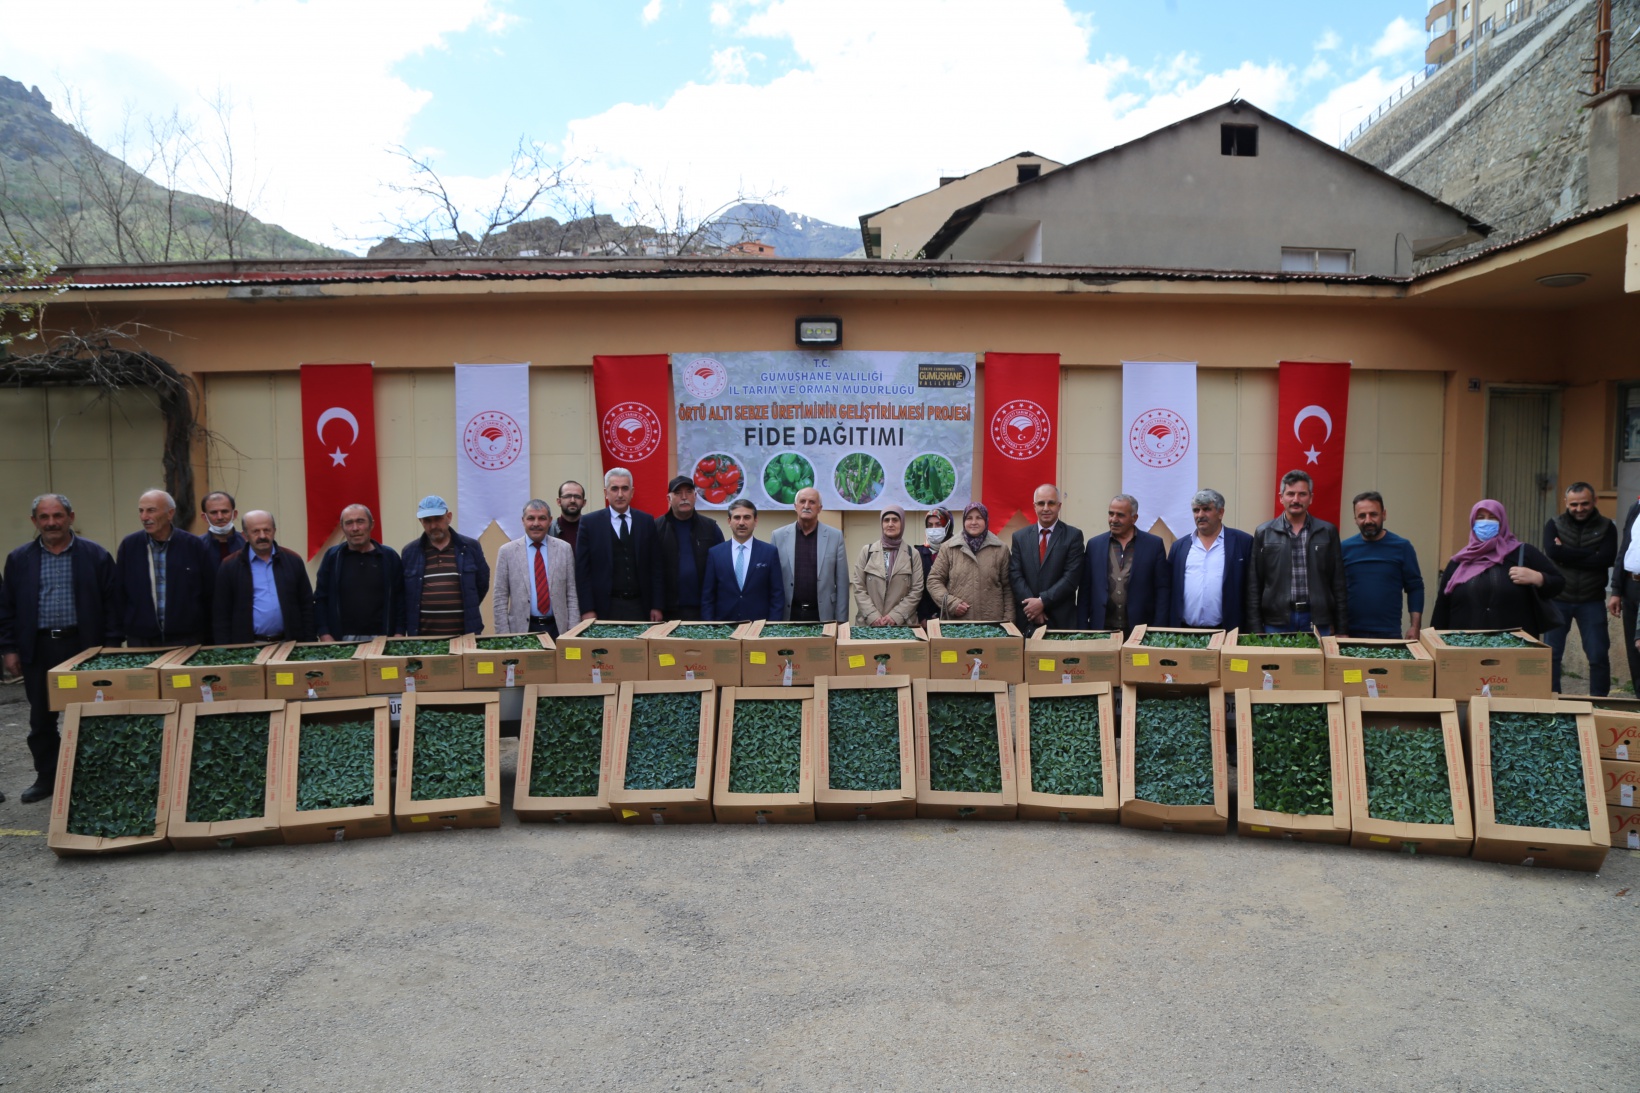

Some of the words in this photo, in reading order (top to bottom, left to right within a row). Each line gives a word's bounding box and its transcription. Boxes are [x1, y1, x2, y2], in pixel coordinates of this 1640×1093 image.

[813, 358, 831, 368] T.C.
[760, 371, 832, 382] GÜMÜŞHANE
[836, 371, 883, 382] VALİLİĞİ
[919, 371, 963, 382] GÜMÜŞHANE
[742, 385, 778, 395] TARIM
[781, 385, 796, 394] VE
[800, 384, 839, 394] ORMAN
[842, 383, 915, 395] MÜDÜRLÜĞÜ
[678, 402, 706, 421] ÖRTÜ
[708, 405, 733, 420] ALTI
[735, 405, 768, 420] SEBZE
[772, 401, 837, 420] ÜRETİMİNİN
[838, 401, 924, 423] GELİŞTİRİLMESİ
[928, 402, 971, 421] PROJESİ
[744, 422, 796, 447] FİDE
[803, 421, 904, 447] DAĞITIMI
